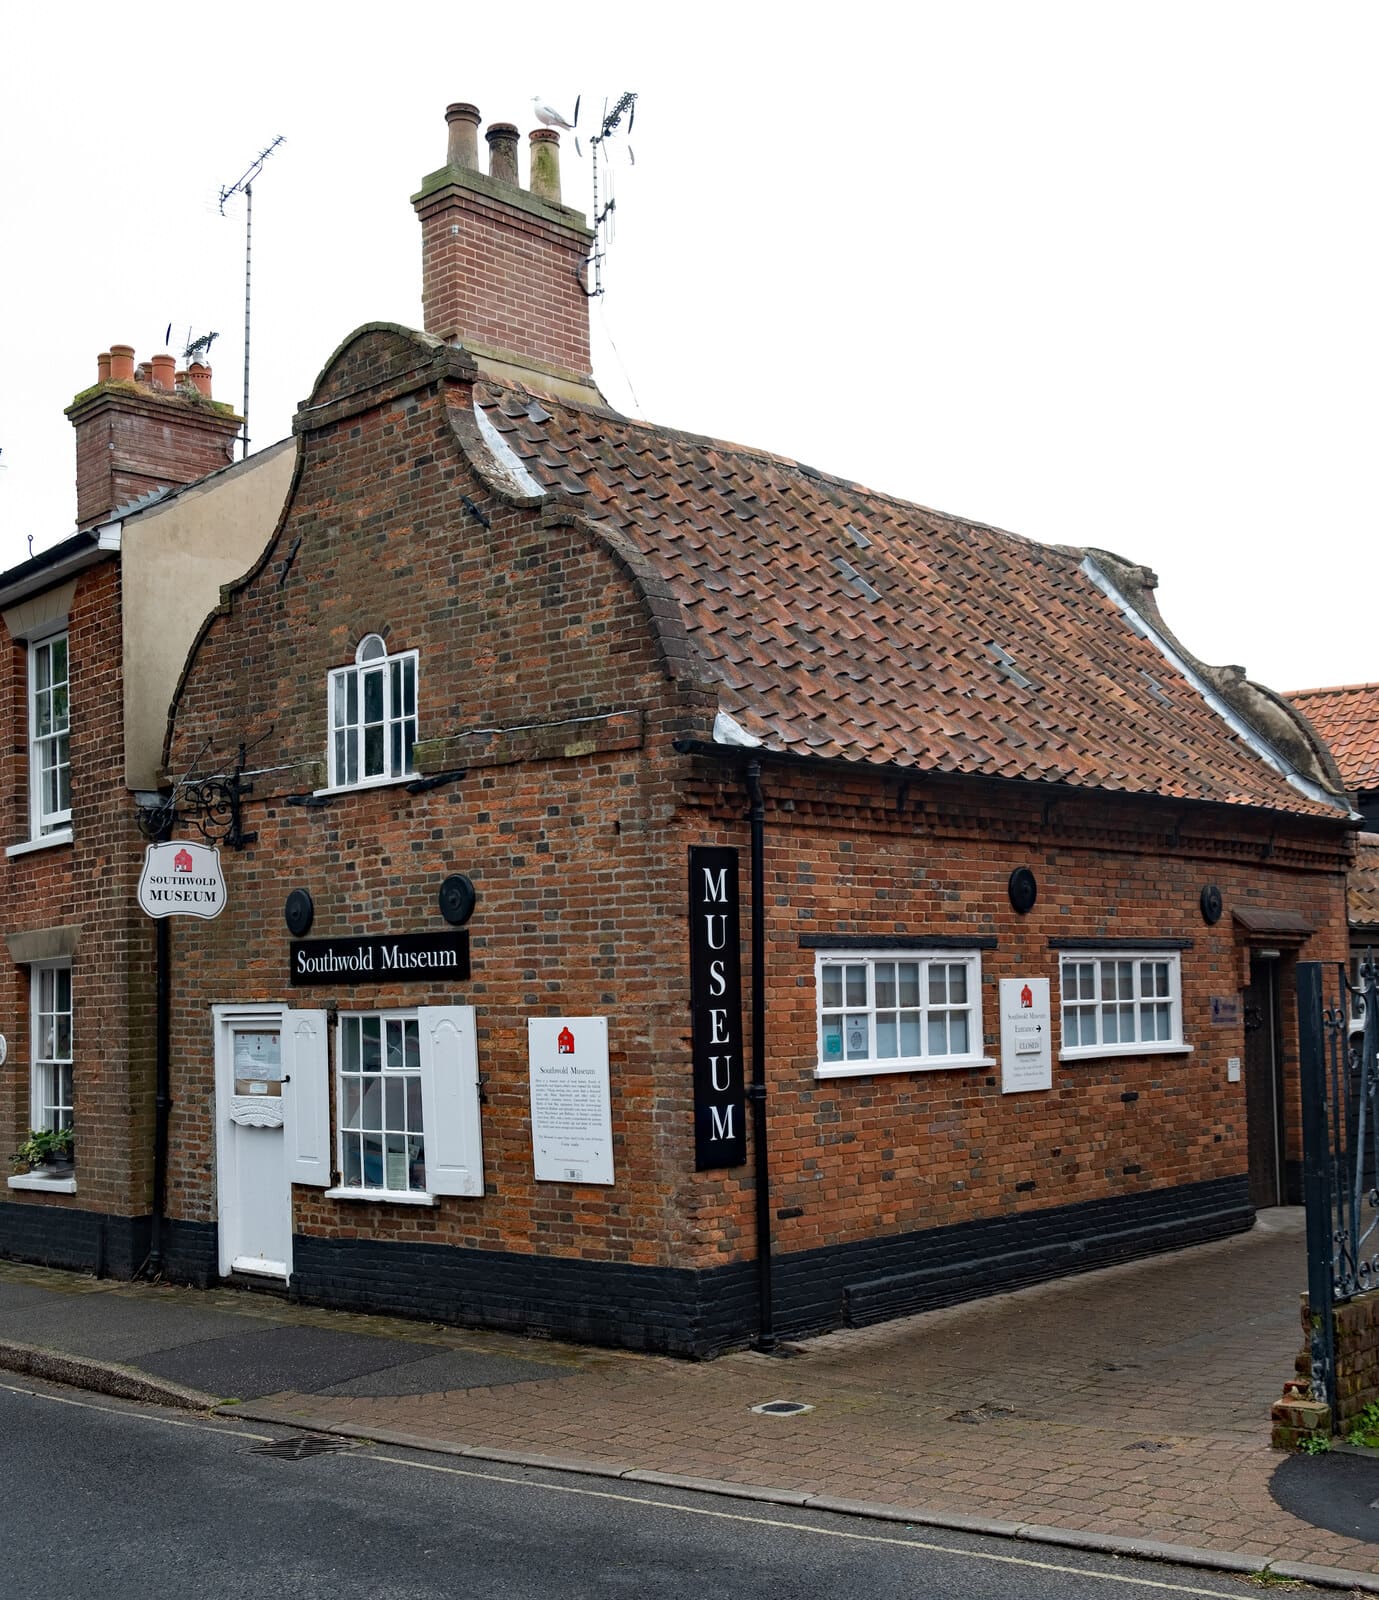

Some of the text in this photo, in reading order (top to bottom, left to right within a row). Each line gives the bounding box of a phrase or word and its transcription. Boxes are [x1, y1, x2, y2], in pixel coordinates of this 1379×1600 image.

[150, 876, 216, 886] SOUTHWOLD
[150, 890, 216, 902] MUSEUM
[297, 945, 458, 973] Southwold Museum
[702, 867, 735, 1141] MUSEUM
[1015, 1025, 1035, 1033] Entrance
[540, 1066, 595, 1075] Southwold Museum
